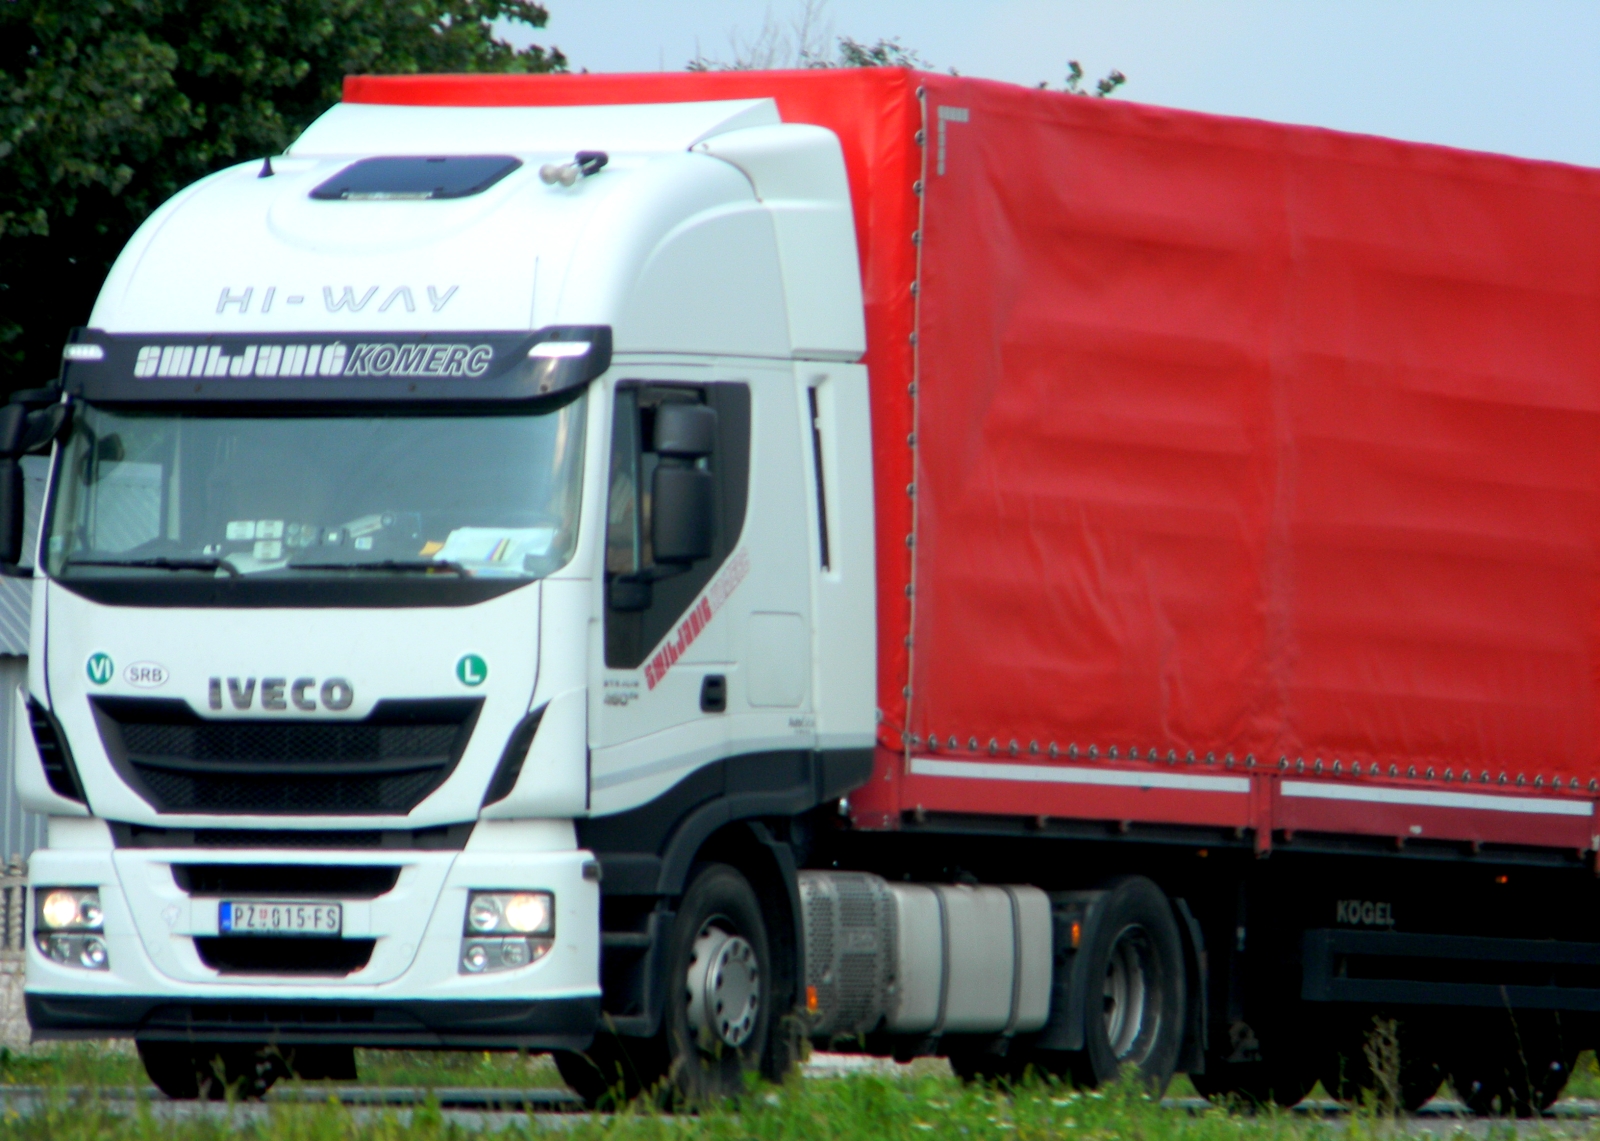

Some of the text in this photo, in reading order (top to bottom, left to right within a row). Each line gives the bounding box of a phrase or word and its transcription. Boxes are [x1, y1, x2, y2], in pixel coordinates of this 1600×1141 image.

[344, 343, 494, 378] KOMERC
[129, 667, 163, 684] SRB
[463, 657, 481, 683] L
[208, 676, 354, 711] IVECO
